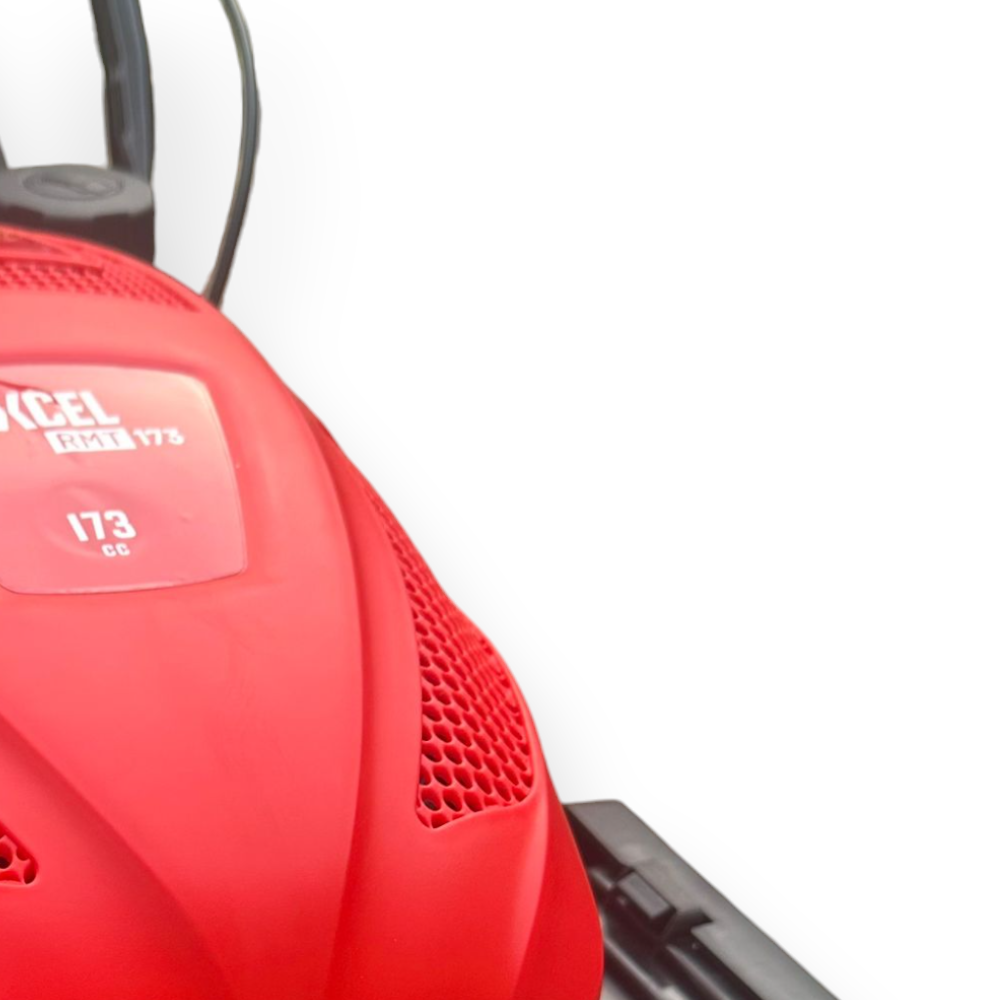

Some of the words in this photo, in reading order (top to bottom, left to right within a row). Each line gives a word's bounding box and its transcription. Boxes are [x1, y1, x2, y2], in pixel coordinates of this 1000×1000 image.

[54, 430, 124, 451] RMT
[132, 426, 185, 447] 173
[66, 509, 137, 543] 173
